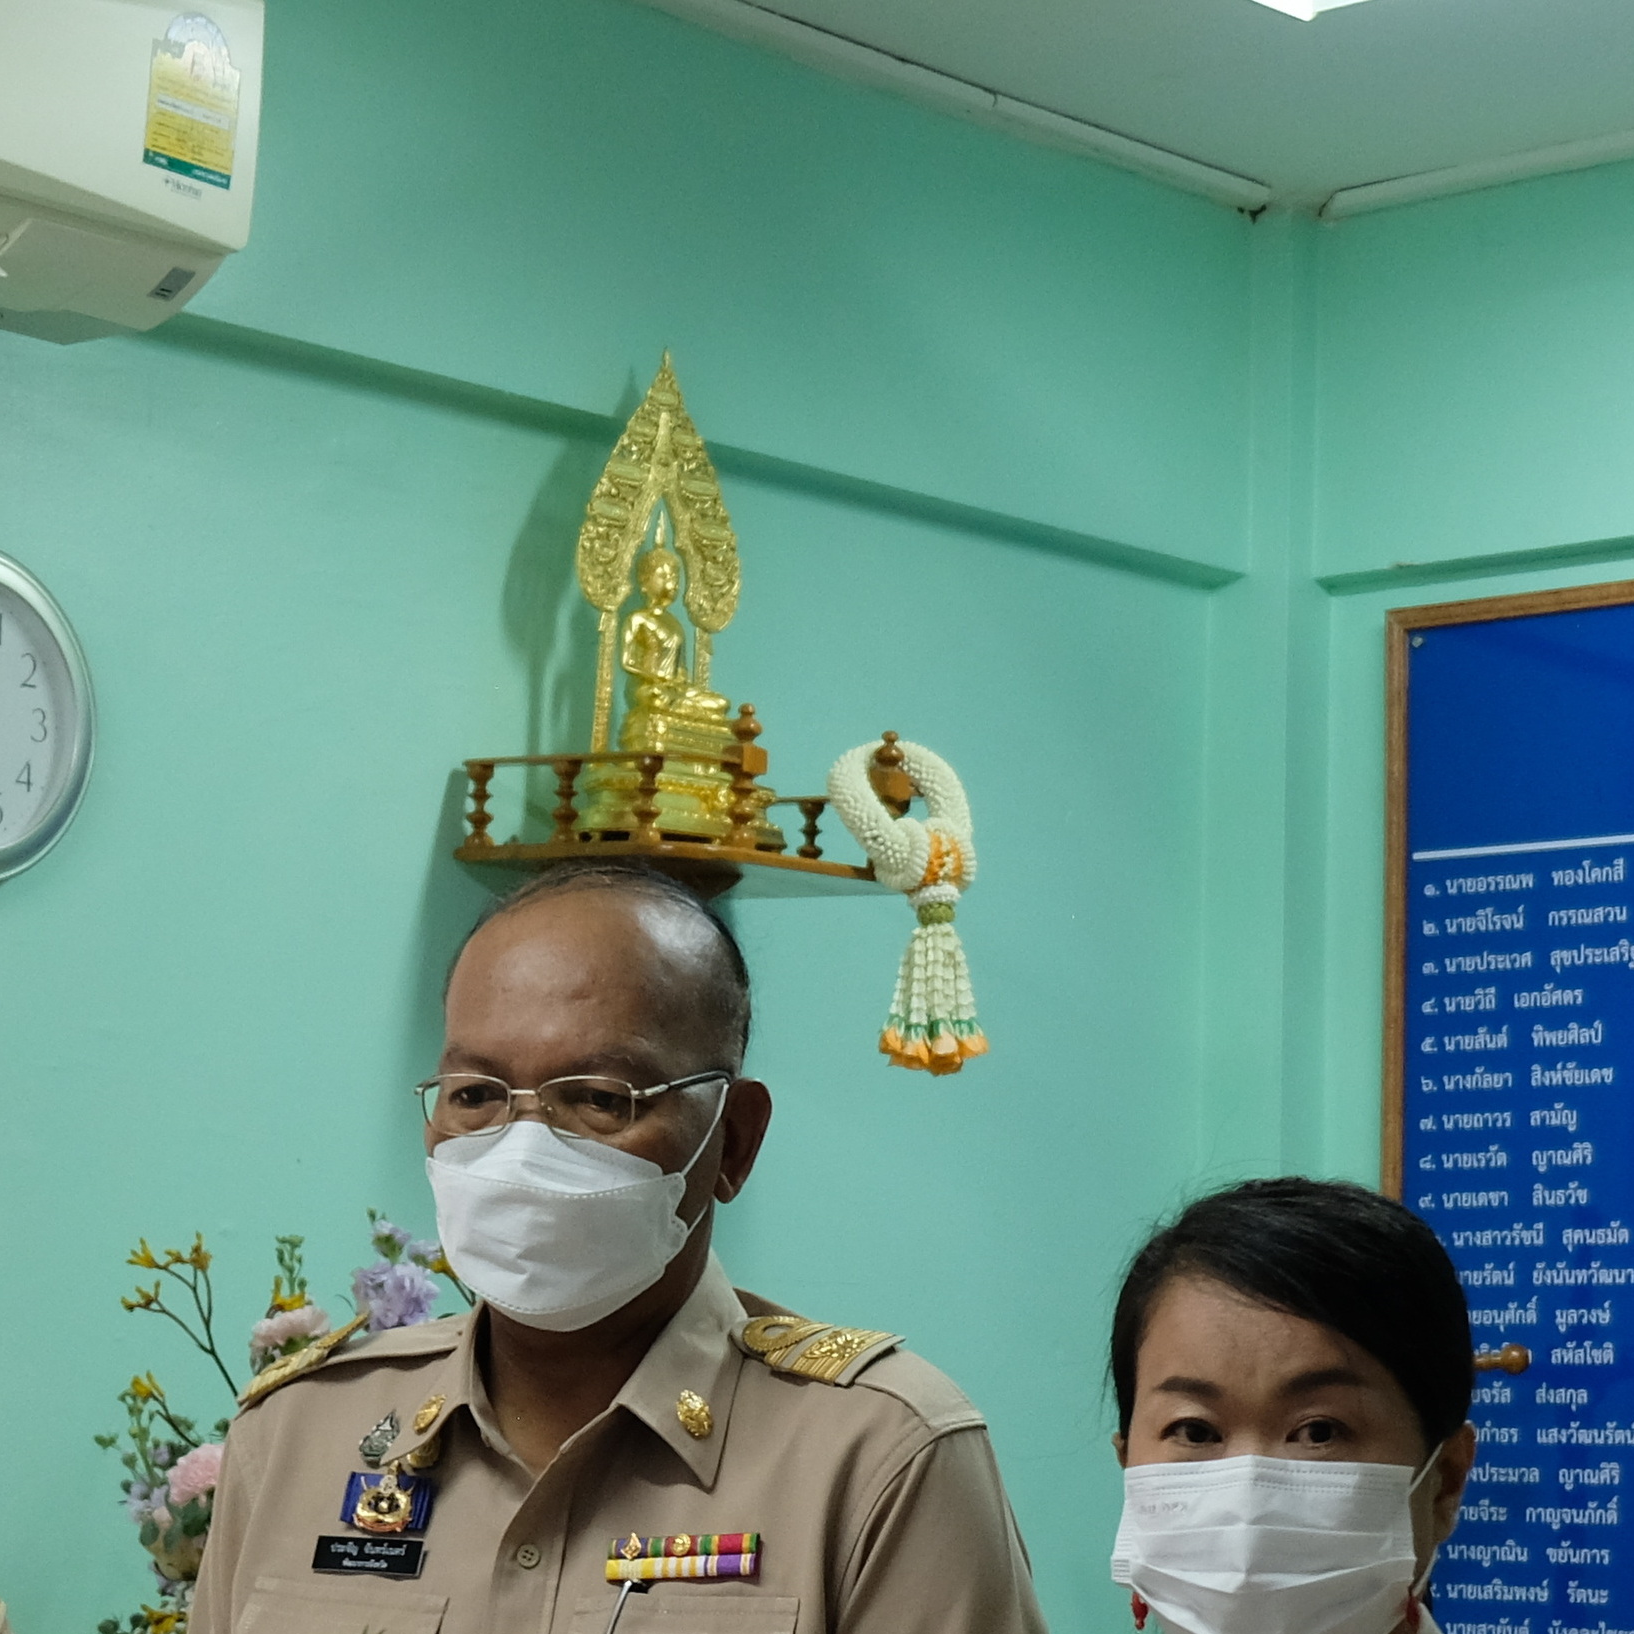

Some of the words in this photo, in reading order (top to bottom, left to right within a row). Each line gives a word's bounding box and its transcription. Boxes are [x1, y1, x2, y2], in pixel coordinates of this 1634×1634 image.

[20, 652, 37, 688] 2
[30, 707, 48, 743] 3
[15, 760, 33, 793] 4
[1446, 874, 1533, 894] นายอรรณพ
[1445, 951, 1532, 972] นายประเวศ
[1444, 1025, 1507, 1051] นายสันต์
[1532, 1020, 1602, 1046] ทิพยศิลป์
[1443, 1066, 1512, 1090] นางกัลยา
[1442, 1112, 1511, 1129] นายถาวร
[1530, 1103, 1577, 1132] สามัญ
[1556, 1301, 1611, 1332] มูลวงษ์
[1536, 1383, 1587, 1411] ส่งสกุล
[1526, 1496, 1618, 1530] กาญจนภักดิ์
[1546, 1541, 1609, 1565] ขยันการ
[1447, 1578, 1549, 1602] นายเสริมพงษ์
